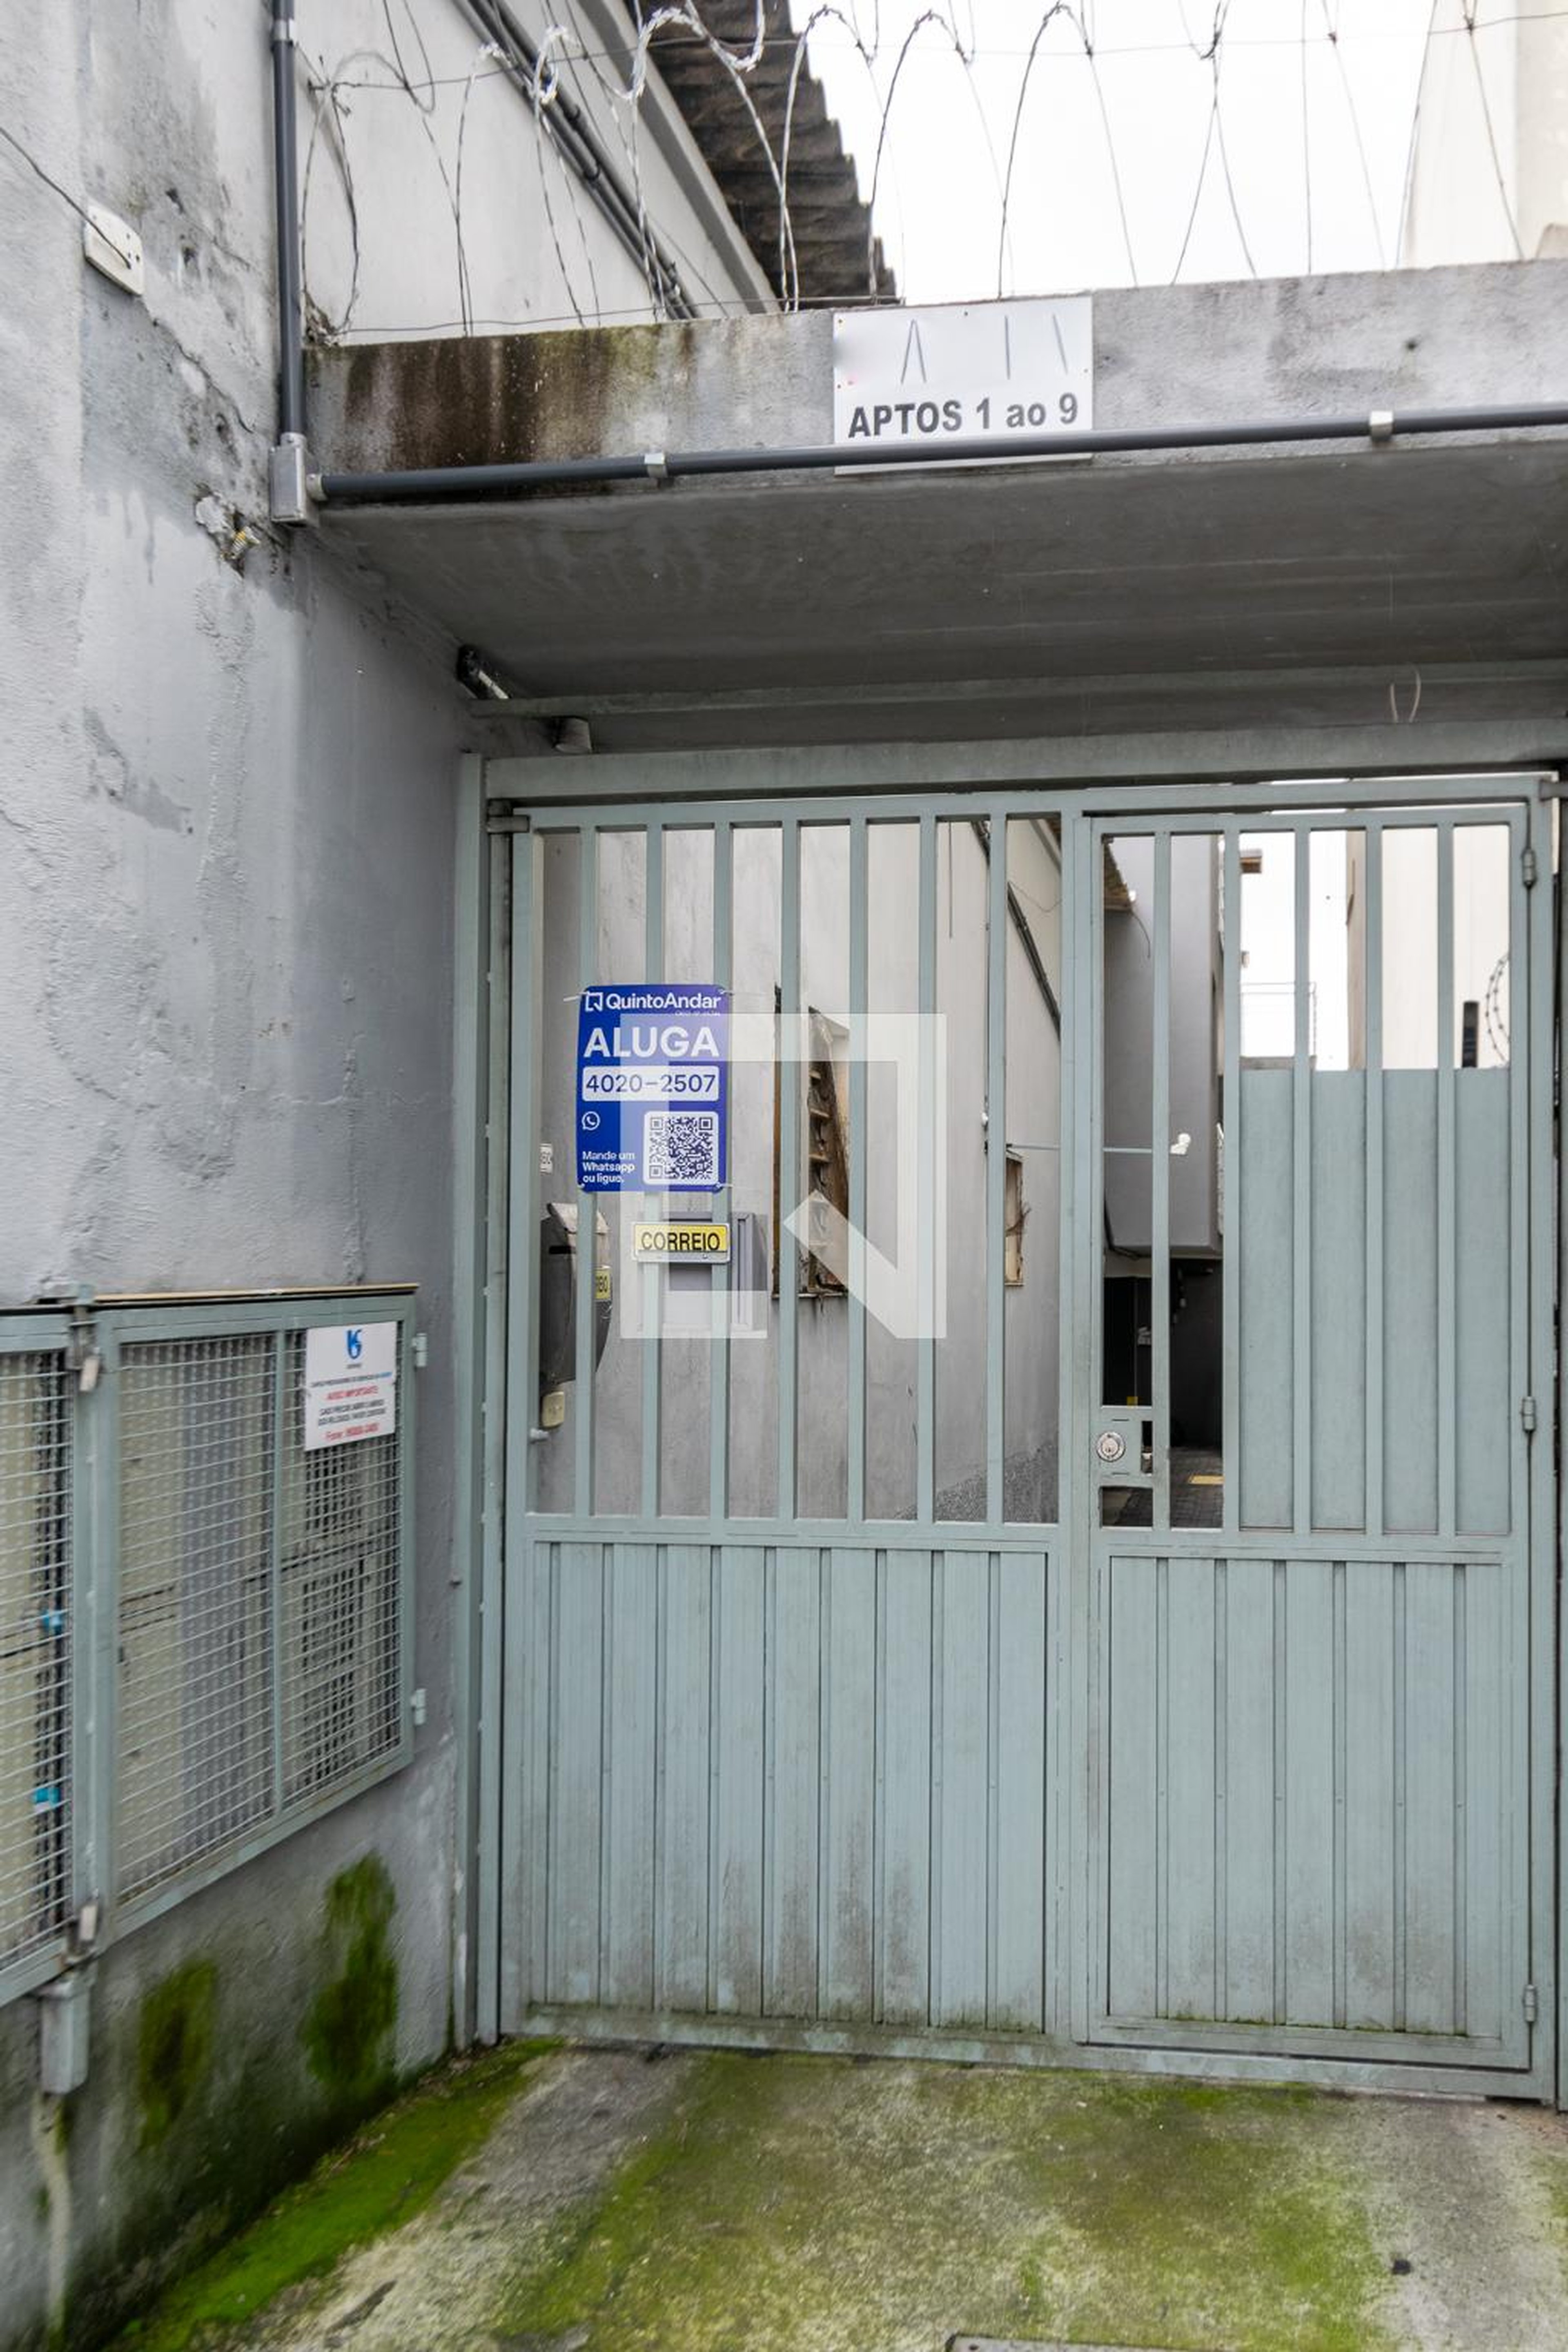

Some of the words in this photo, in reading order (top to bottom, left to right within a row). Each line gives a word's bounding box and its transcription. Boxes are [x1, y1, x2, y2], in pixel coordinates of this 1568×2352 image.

[847, 399, 962, 438] APTOS
[976, 397, 990, 430] 1
[1006, 403, 1047, 429] ao
[1059, 392, 1078, 425] 9
[606, 992, 722, 1010] QuintoAndar
[583, 1027, 720, 1058] ALUGA
[586, 1074, 716, 1093] 4020-2507
[582, 1151, 617, 1160] Mande
[583, 1162, 635, 1174] Whatsapp
[583, 1175, 596, 1183] ou
[641, 1231, 721, 1251] CORREIO
